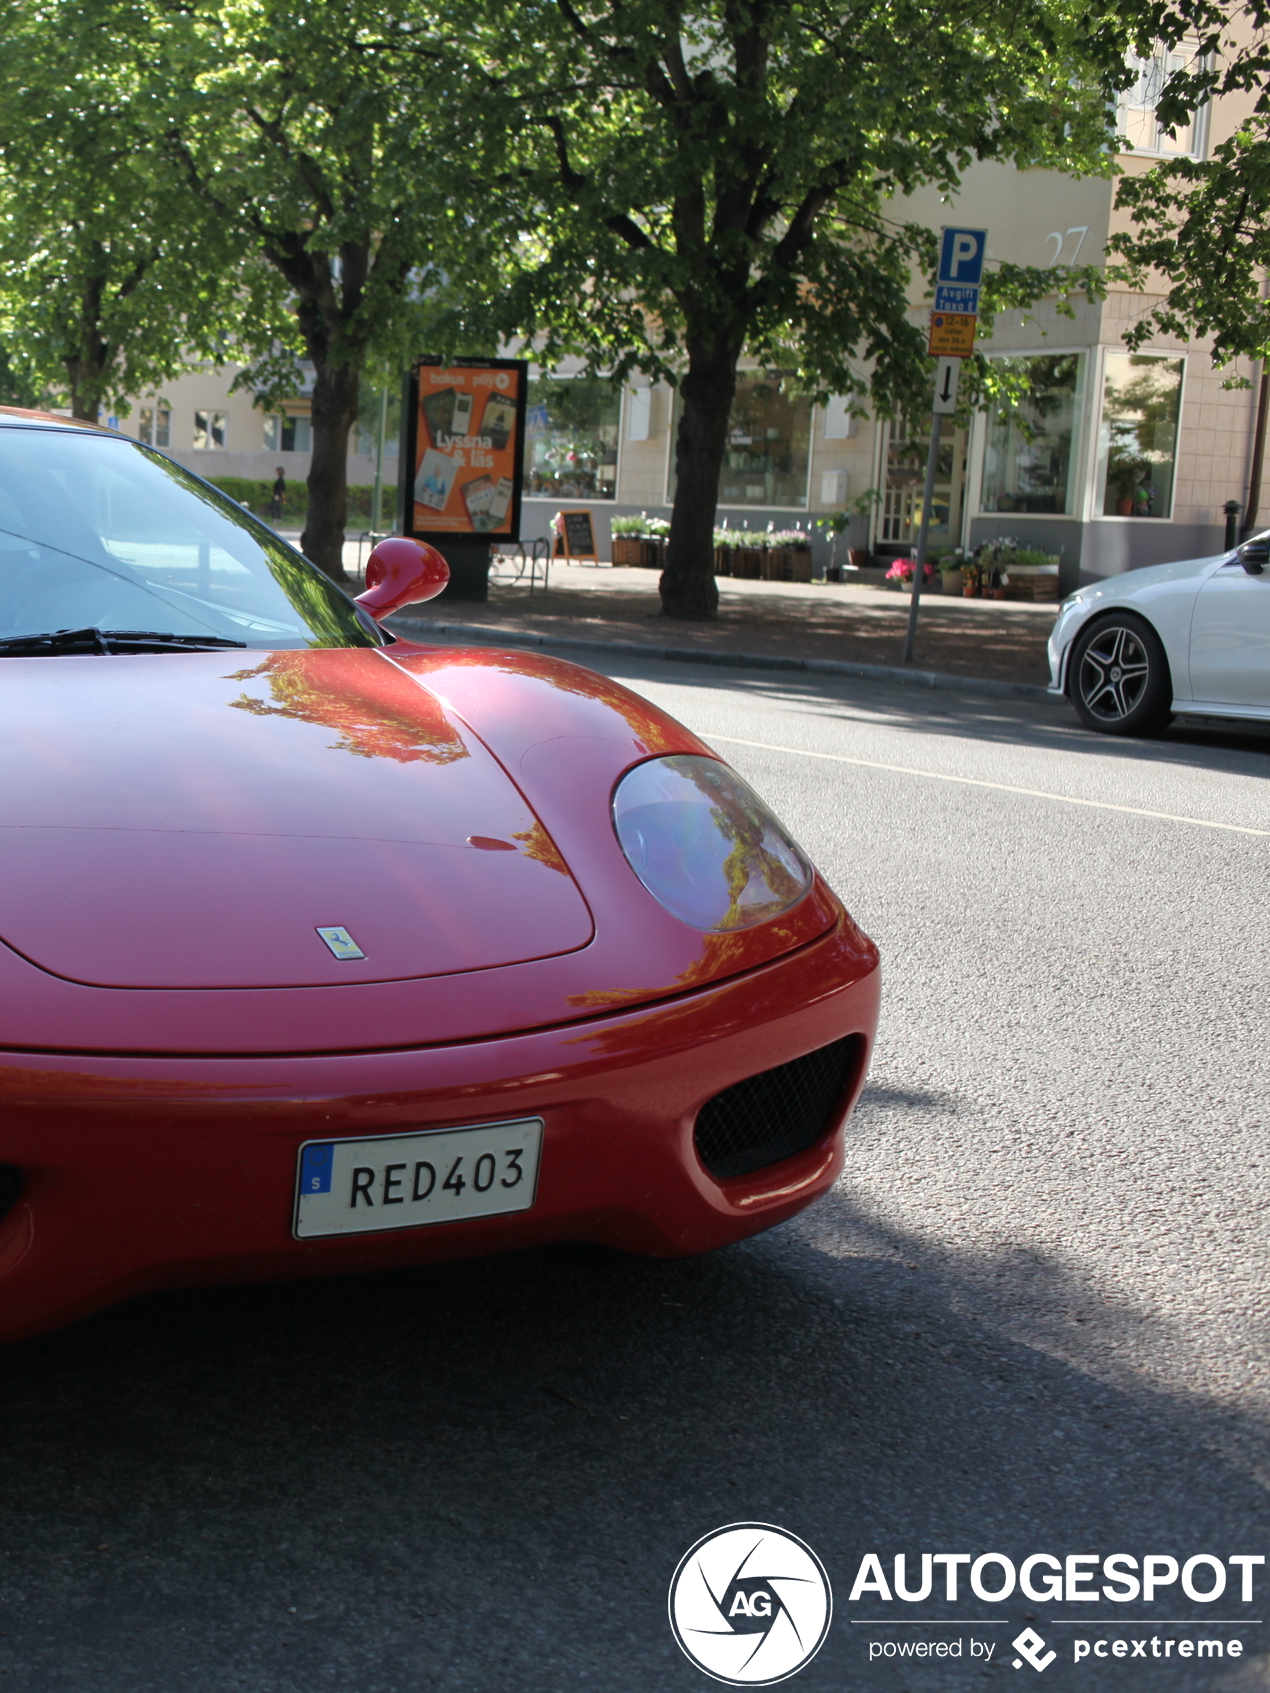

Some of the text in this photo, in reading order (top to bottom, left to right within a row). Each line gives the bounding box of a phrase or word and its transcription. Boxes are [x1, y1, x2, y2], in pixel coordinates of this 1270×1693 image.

[1044, 225, 1089, 268] 27
[949, 233, 978, 278] P
[941, 287, 974, 301] Avgift
[939, 300, 974, 312] Taxa E
[945, 316, 970, 327] 12-16
[430, 372, 465, 386] bokus
[436, 430, 493, 452] Lyssna
[452, 449, 494, 468] & läs
[311, 1177, 321, 1190] S
[350, 1148, 525, 1208] RED403
